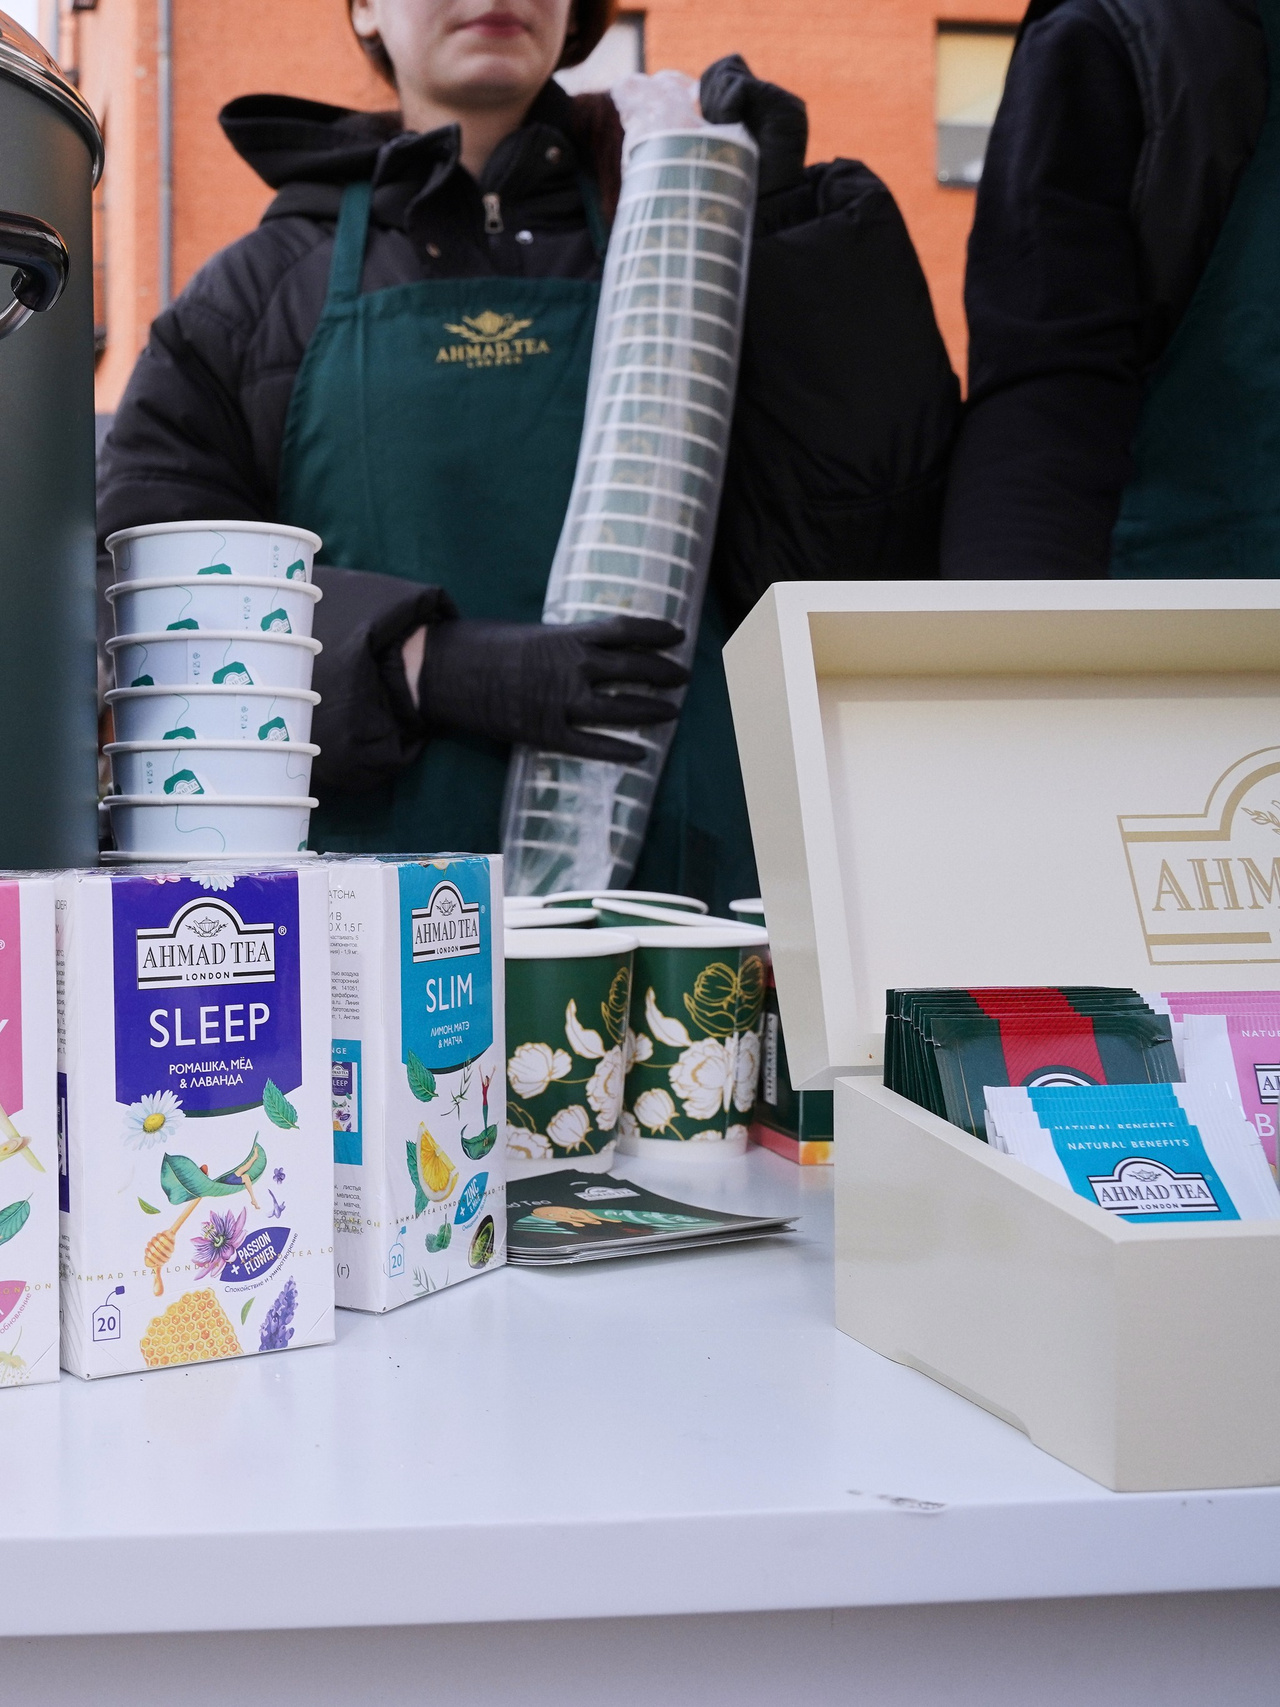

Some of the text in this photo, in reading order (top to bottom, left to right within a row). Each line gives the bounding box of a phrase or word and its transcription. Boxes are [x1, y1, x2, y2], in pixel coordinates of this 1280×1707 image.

[1152, 857, 1280, 911] AHM
[329, 889, 356, 899] ATCHA
[415, 918, 478, 945] AHMAD TEA
[143, 940, 271, 969] AHMAD TEA
[436, 945, 459, 954] LONDON
[186, 971, 230, 981] LONDON
[426, 972, 473, 1013] SLIM
[149, 1002, 270, 1048] SLEEP
[430, 1021, 470, 1037] ЛИМОН, МАТЭ
[443, 1035, 463, 1047] МАТЧА
[1241, 1030, 1280, 1038] NATU
[169, 1058, 253, 1075] РОМАШКА, МЁД
[179, 1073, 243, 1088] & ЛАВАНДА
[332, 1079, 348, 1087] LEEP
[1067, 1139, 1189, 1151] NATURAL BENEFITS
[1102, 1183, 1210, 1202] AHMAD TEA
[238, 1231, 271, 1261] PASSION
[244, 1246, 277, 1275] FLOWER
[392, 1253, 403, 1269] 20
[77, 1272, 124, 1281] AHMAD
[225, 1281, 264, 1293] Спокойствие
[0, 1293, 31, 1334] обновление
[97, 1316, 116, 1332] 20
